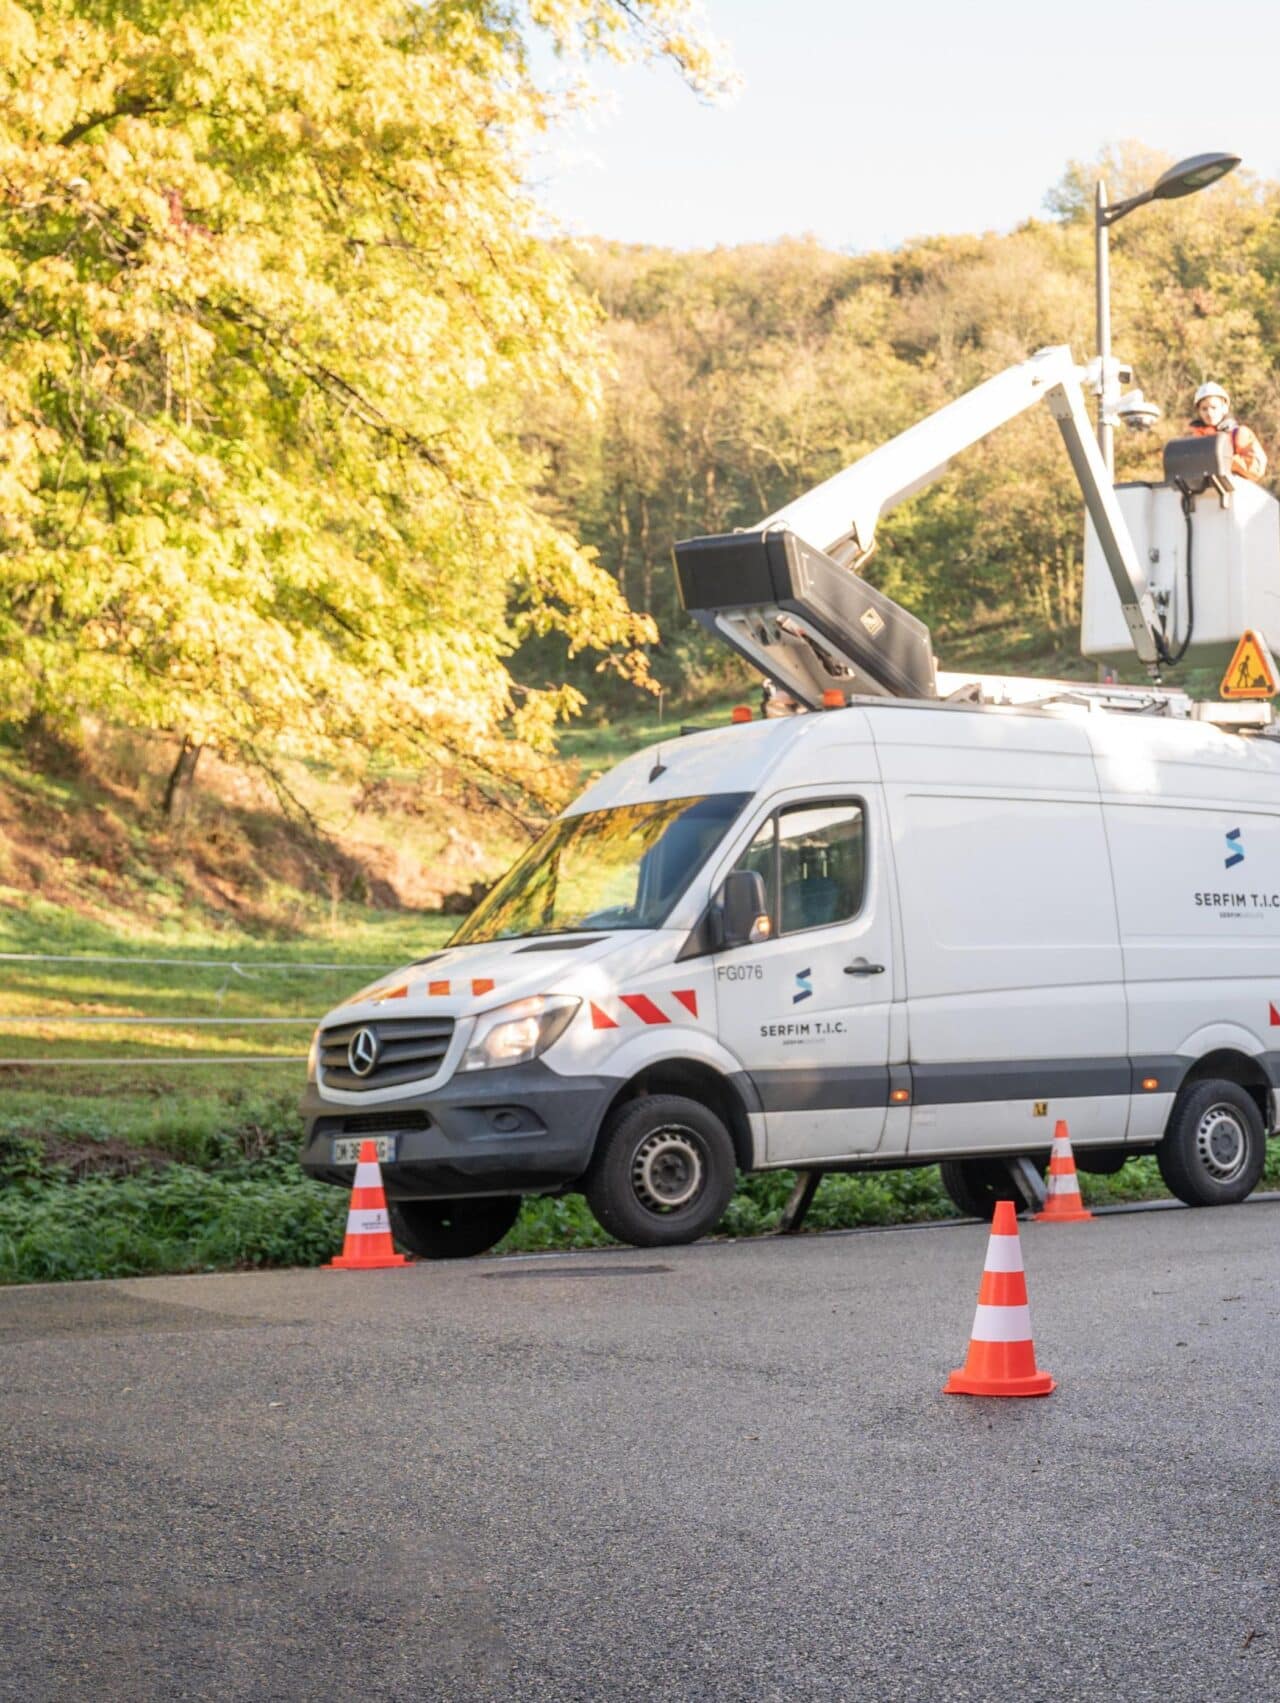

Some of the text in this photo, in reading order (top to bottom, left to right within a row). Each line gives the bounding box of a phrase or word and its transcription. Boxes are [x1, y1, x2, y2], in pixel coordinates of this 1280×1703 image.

[1194, 893, 1246, 907] SERFIM
[717, 965, 763, 981] FG076
[760, 1022, 847, 1037] SERFIM T.I.C.
